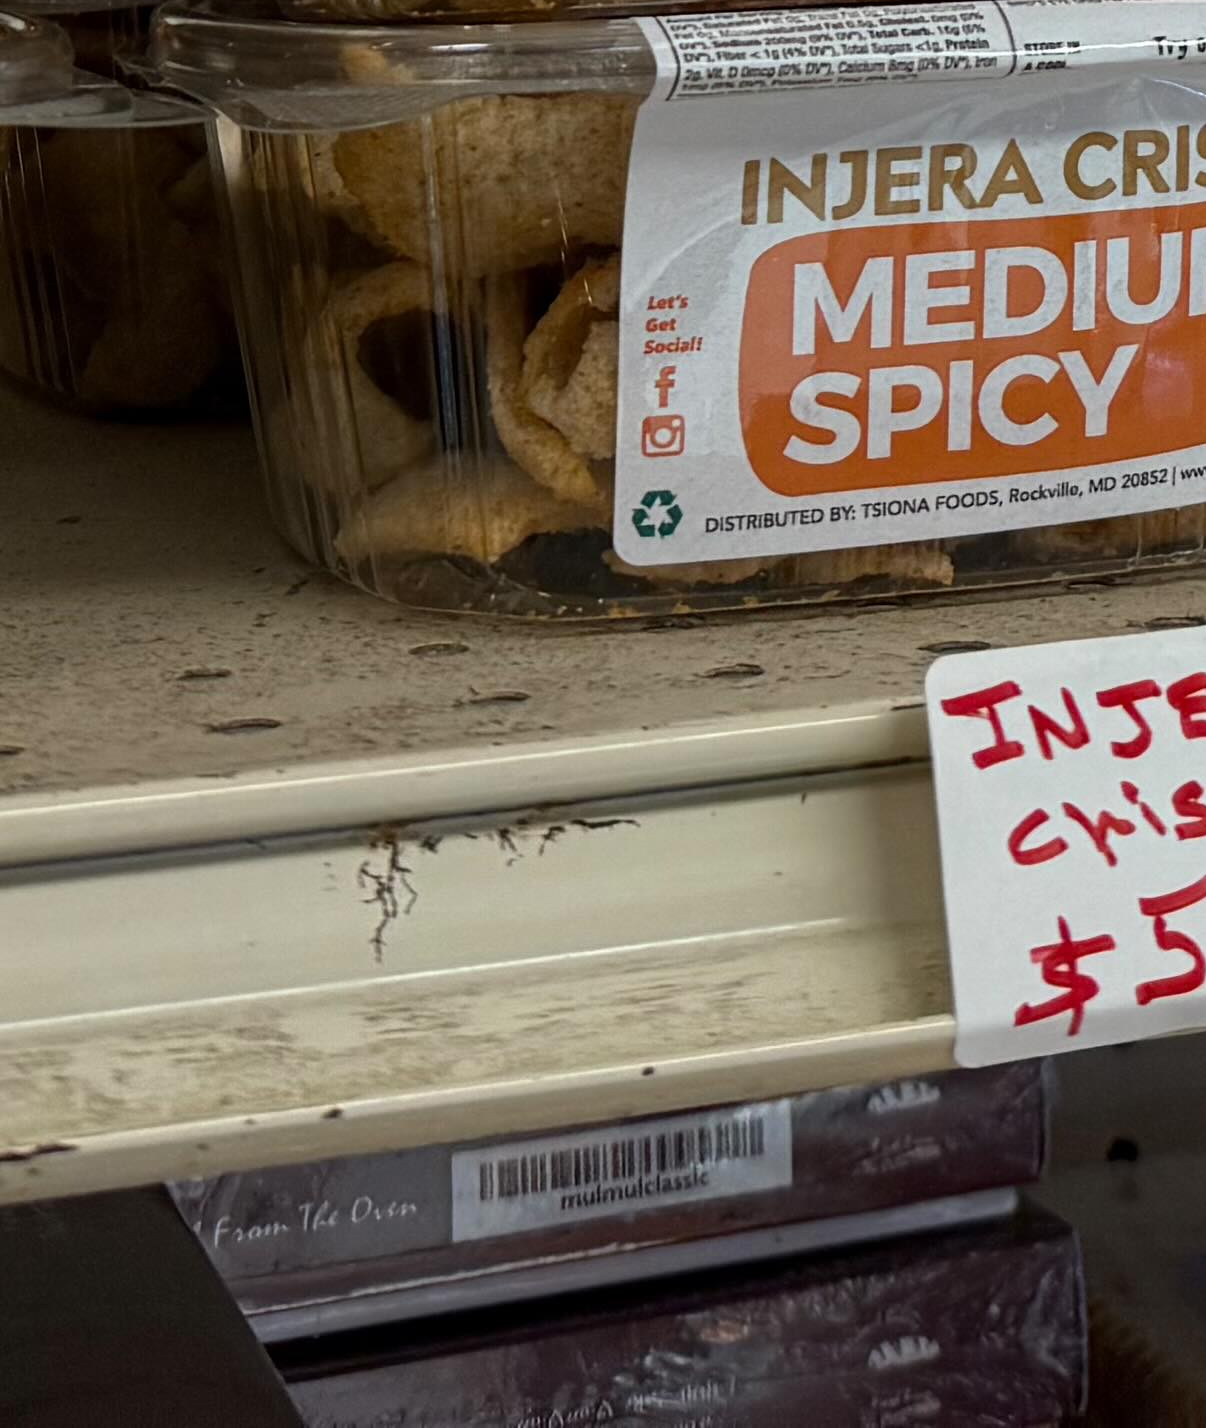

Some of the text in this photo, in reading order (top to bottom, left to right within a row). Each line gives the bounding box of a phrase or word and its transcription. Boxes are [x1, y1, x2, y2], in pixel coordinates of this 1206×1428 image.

[740, 137, 1045, 227] INJERA
[647, 295, 689, 311] Let's
[645, 317, 677, 334] Get
[642, 336, 703, 355] Social!
[782, 343, 1141, 465] SPICY
[705, 507, 824, 533] DISTRIBUTED
[829, 504, 857, 523] BY:
[861, 498, 930, 520] TSIONA
[935, 490, 1003, 511] FOODS,
[1008, 479, 1084, 505] Rockville,
[1088, 475, 1117, 494] MD
[1121, 468, 1168, 489] 20852
[298, 1199, 339, 1232] The
